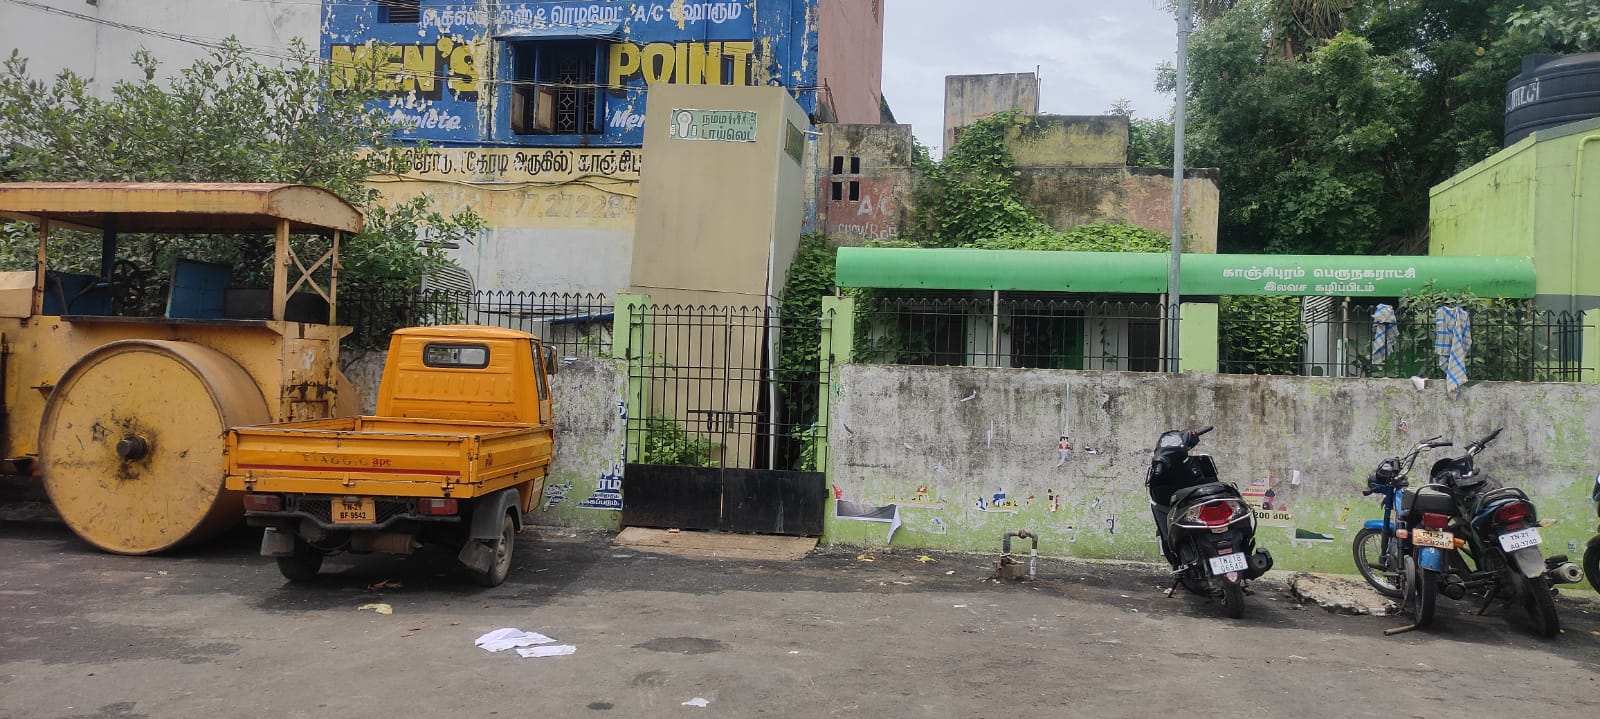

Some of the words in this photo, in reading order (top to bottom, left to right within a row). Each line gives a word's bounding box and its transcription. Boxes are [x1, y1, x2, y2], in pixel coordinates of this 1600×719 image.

[634, 3, 664, 24] A/C
[331, 37, 478, 92] MEN'S
[609, 41, 754, 88] POINT
[1222, 266, 1305, 280] காஞ்சிபுரம்
[1313, 267, 1416, 281] பெருநகராட்சி
[1264, 282, 1308, 292] இலவச
[1314, 281, 1375, 295] கழிப்பிடம்
[302, 453, 368, 466] PAGGO
[372, 457, 392, 467] ape
[342, 503, 363, 511] TN-21
[340, 512, 367, 520] BF-9542
